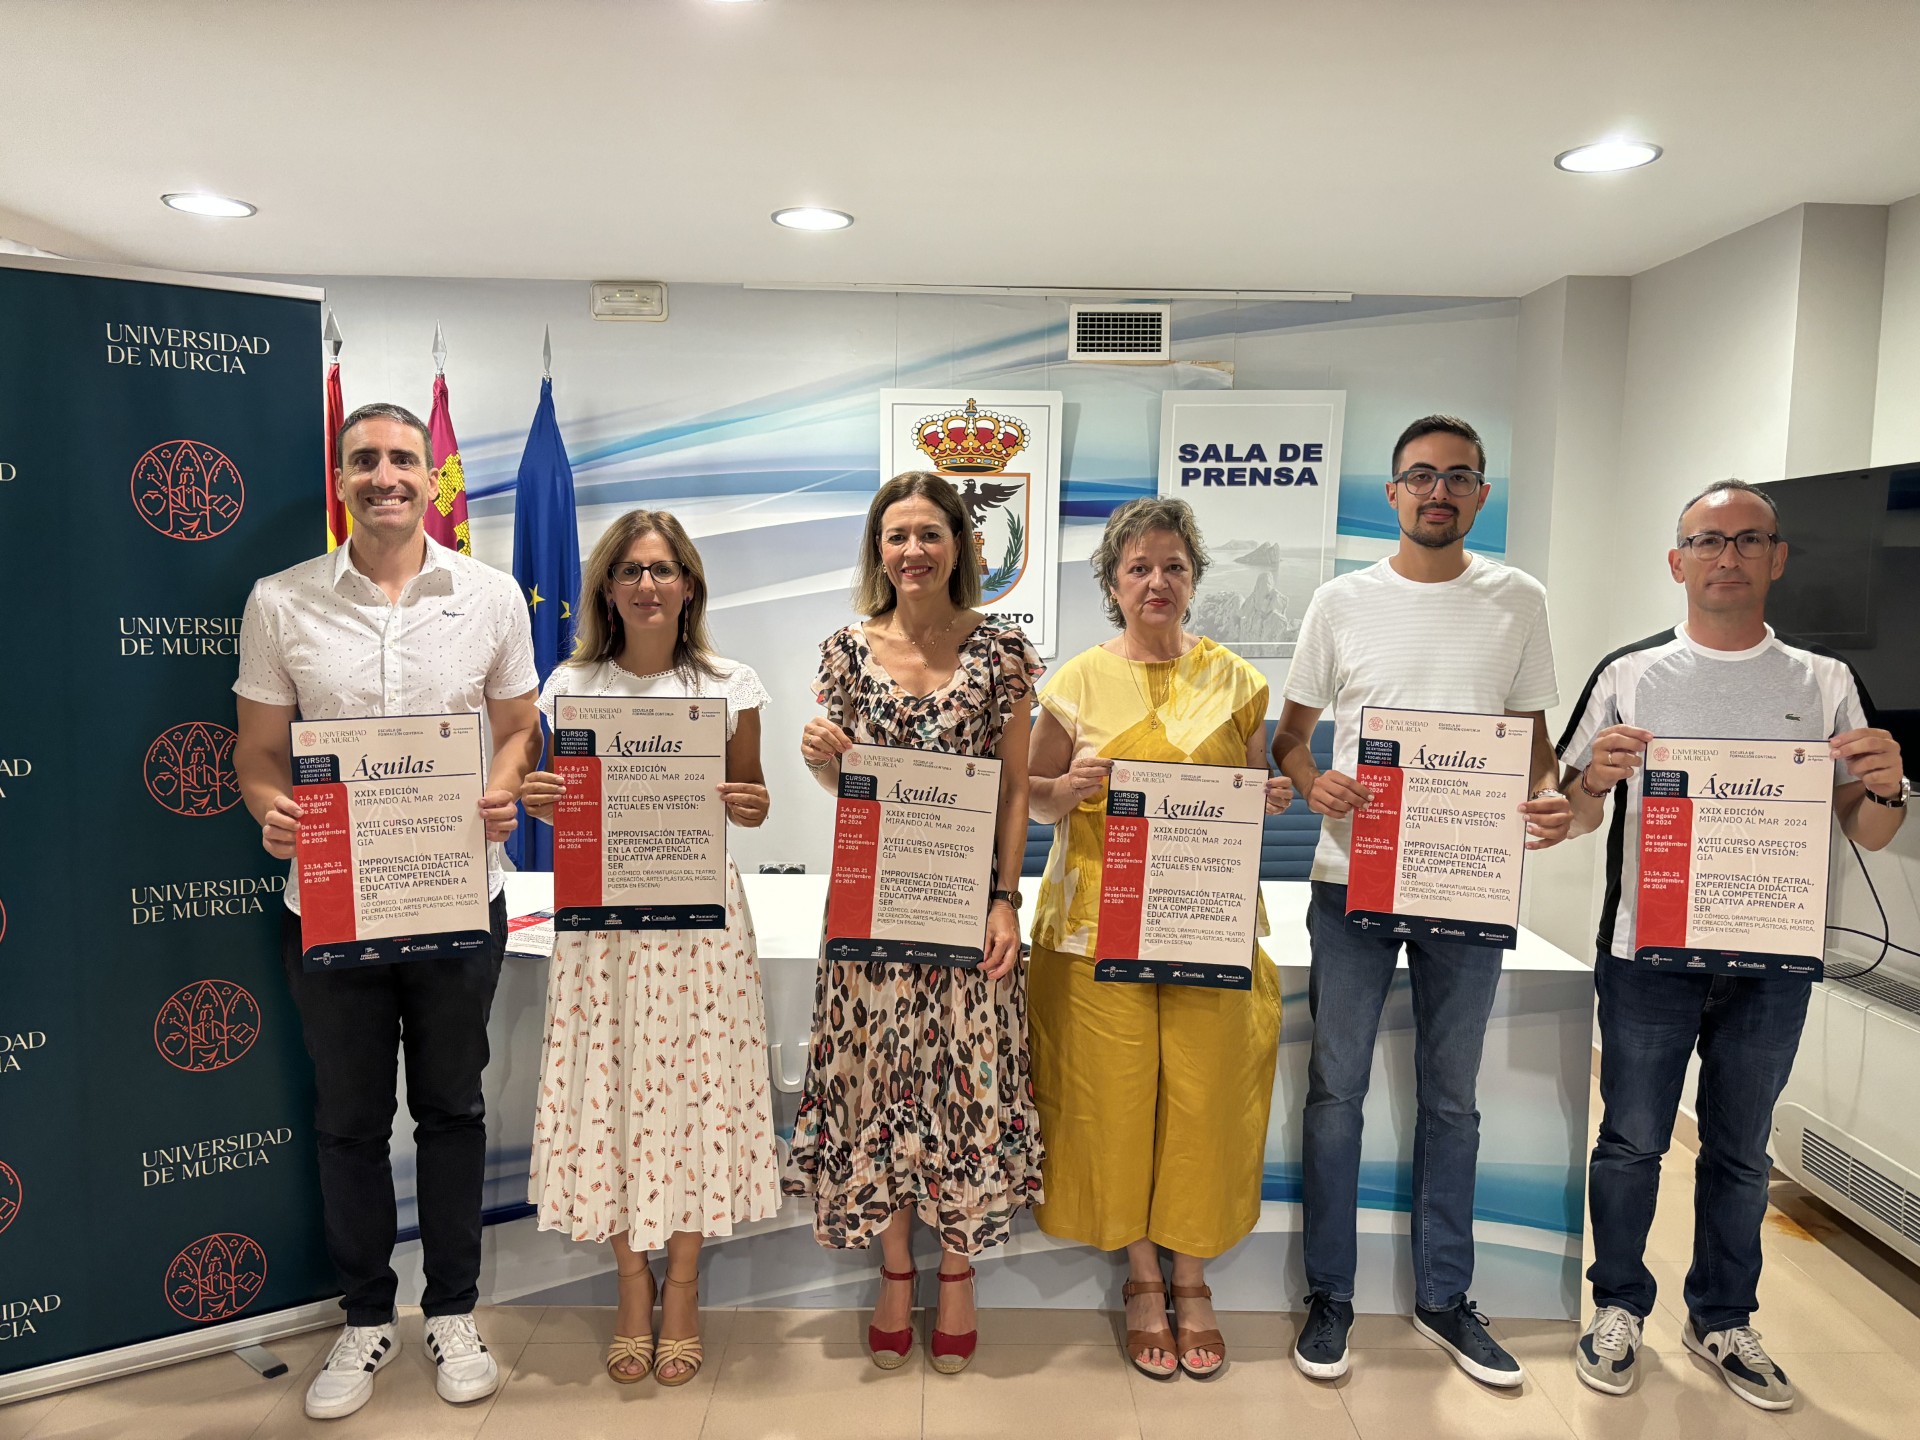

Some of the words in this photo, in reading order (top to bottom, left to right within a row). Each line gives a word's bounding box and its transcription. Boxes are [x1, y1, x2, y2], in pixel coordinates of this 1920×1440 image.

[106, 322, 270, 356] UNIVERSIDAD
[107, 345, 141, 367] DE
[150, 350, 246, 375] MURCIA
[1178, 443, 1267, 463] SALA
[1279, 443, 1323, 463] DE
[1181, 467, 1319, 487] PRENSA
[119, 616, 243, 636] UNIVERSID
[120, 637, 155, 656] DE
[162, 637, 240, 656] MURCI
[1386, 719, 1428, 727] UNIVERSIDAD
[1396, 725, 1421, 733] MURCIA
[319, 730, 366, 738] UNIVERSIDAD
[331, 736, 360, 744] MURCIA
[606, 731, 682, 756] Águilas
[863, 754, 903, 764] UNIVERSIDAD
[1409, 744, 1486, 769] Águilas
[352, 753, 434, 780] Águilas
[630, 763, 666, 772] EDICIÓN
[873, 760, 897, 769] MURCIA
[1132, 771, 1171, 779] UNIVERSIDAD
[1431, 778, 1468, 787] EDICIÓN
[1699, 773, 1784, 798] Águilas
[354, 789, 376, 797] XXIX
[379, 785, 418, 795] EDICIÓN
[886, 778, 957, 804] Águilas
[1408, 784, 1448, 794] MIRANDO
[1485, 790, 1506, 798] 2024
[355, 797, 398, 806] MIRANDO
[438, 793, 460, 801] 2024
[666, 801, 698, 809] VISIÓN:
[1154, 794, 1224, 819] Águilas
[1407, 806, 1428, 814] XVIII
[1430, 807, 1459, 816] CURSO
[1461, 810, 1505, 820] ASPECTOS
[1724, 807, 1764, 816] EDICIÓN
[886, 809, 904, 817] XXIX
[906, 811, 940, 821] EDICIÓN
[1406, 813, 1448, 824] ACTUALES
[1464, 818, 1498, 827] VISIÓN:
[1699, 815, 1742, 824] MIRANDO
[356, 820, 380, 829] XVIII
[382, 818, 413, 827] CURSO
[416, 815, 462, 825] ASPECTOS
[885, 816, 922, 827] MIRANDO
[935, 822, 952, 830] MAR
[956, 824, 975, 832] 2024
[1405, 821, 1420, 829] GIA
[356, 828, 403, 837] ACTUALES
[406, 826, 417, 834] EN
[420, 822, 455, 833] VISIÓN:
[1174, 827, 1207, 835] EDICIÓN
[357, 838, 374, 846] GIA
[883, 836, 904, 844] XVIII
[906, 839, 932, 847] CURSO
[934, 841, 974, 852] ASPECTOS
[1153, 834, 1189, 842] MIRANDO
[1724, 838, 1755, 846] CURSO
[1758, 839, 1807, 848] ASPECTOS
[882, 844, 922, 854] ACTUALES
[936, 849, 967, 859] VISIÓN:
[882, 851, 896, 859] GIA
[1697, 845, 1743, 854] ACTUALES
[1761, 847, 1798, 856] VISIÓN:
[358, 853, 431, 866] IMPROVISACIÓN
[433, 851, 473, 860] TEATRAL,
[1173, 855, 1199, 863] CURSO
[1201, 857, 1241, 866] ASPECTOS
[359, 864, 419, 875] EXPERIENCIA
[421, 859, 469, 869] DIDÁCTICA
[1150, 862, 1189, 871] ACTUALES
[1203, 864, 1234, 873] VISIÓN:
[387, 869, 450, 881] COMPETENCIA
[1695, 872, 1769, 883] IMPROVISACIÓN
[1772, 876, 1814, 886] TEATRAL,
[131, 876, 286, 905] UNIVERSIDAD
[360, 881, 410, 892] EDUCATIVA
[412, 877, 459, 887] APRENDER
[1695, 880, 1755, 890] EXPERIENCIA
[1758, 882, 1808, 893] DIDÁCTICA
[360, 892, 377, 900] SER
[1722, 889, 1787, 900] COMPETENCIA
[1693, 904, 1711, 912] SER
[1694, 896, 1744, 906] EDUCATIVA
[1746, 899, 1795, 909] APRENDER
[132, 906, 165, 925] DE
[173, 896, 264, 920] MURCIA
[142, 1127, 292, 1167] UNIVERSIDAD
[143, 1166, 175, 1187] DE
[182, 1149, 270, 1180] MURCIA
